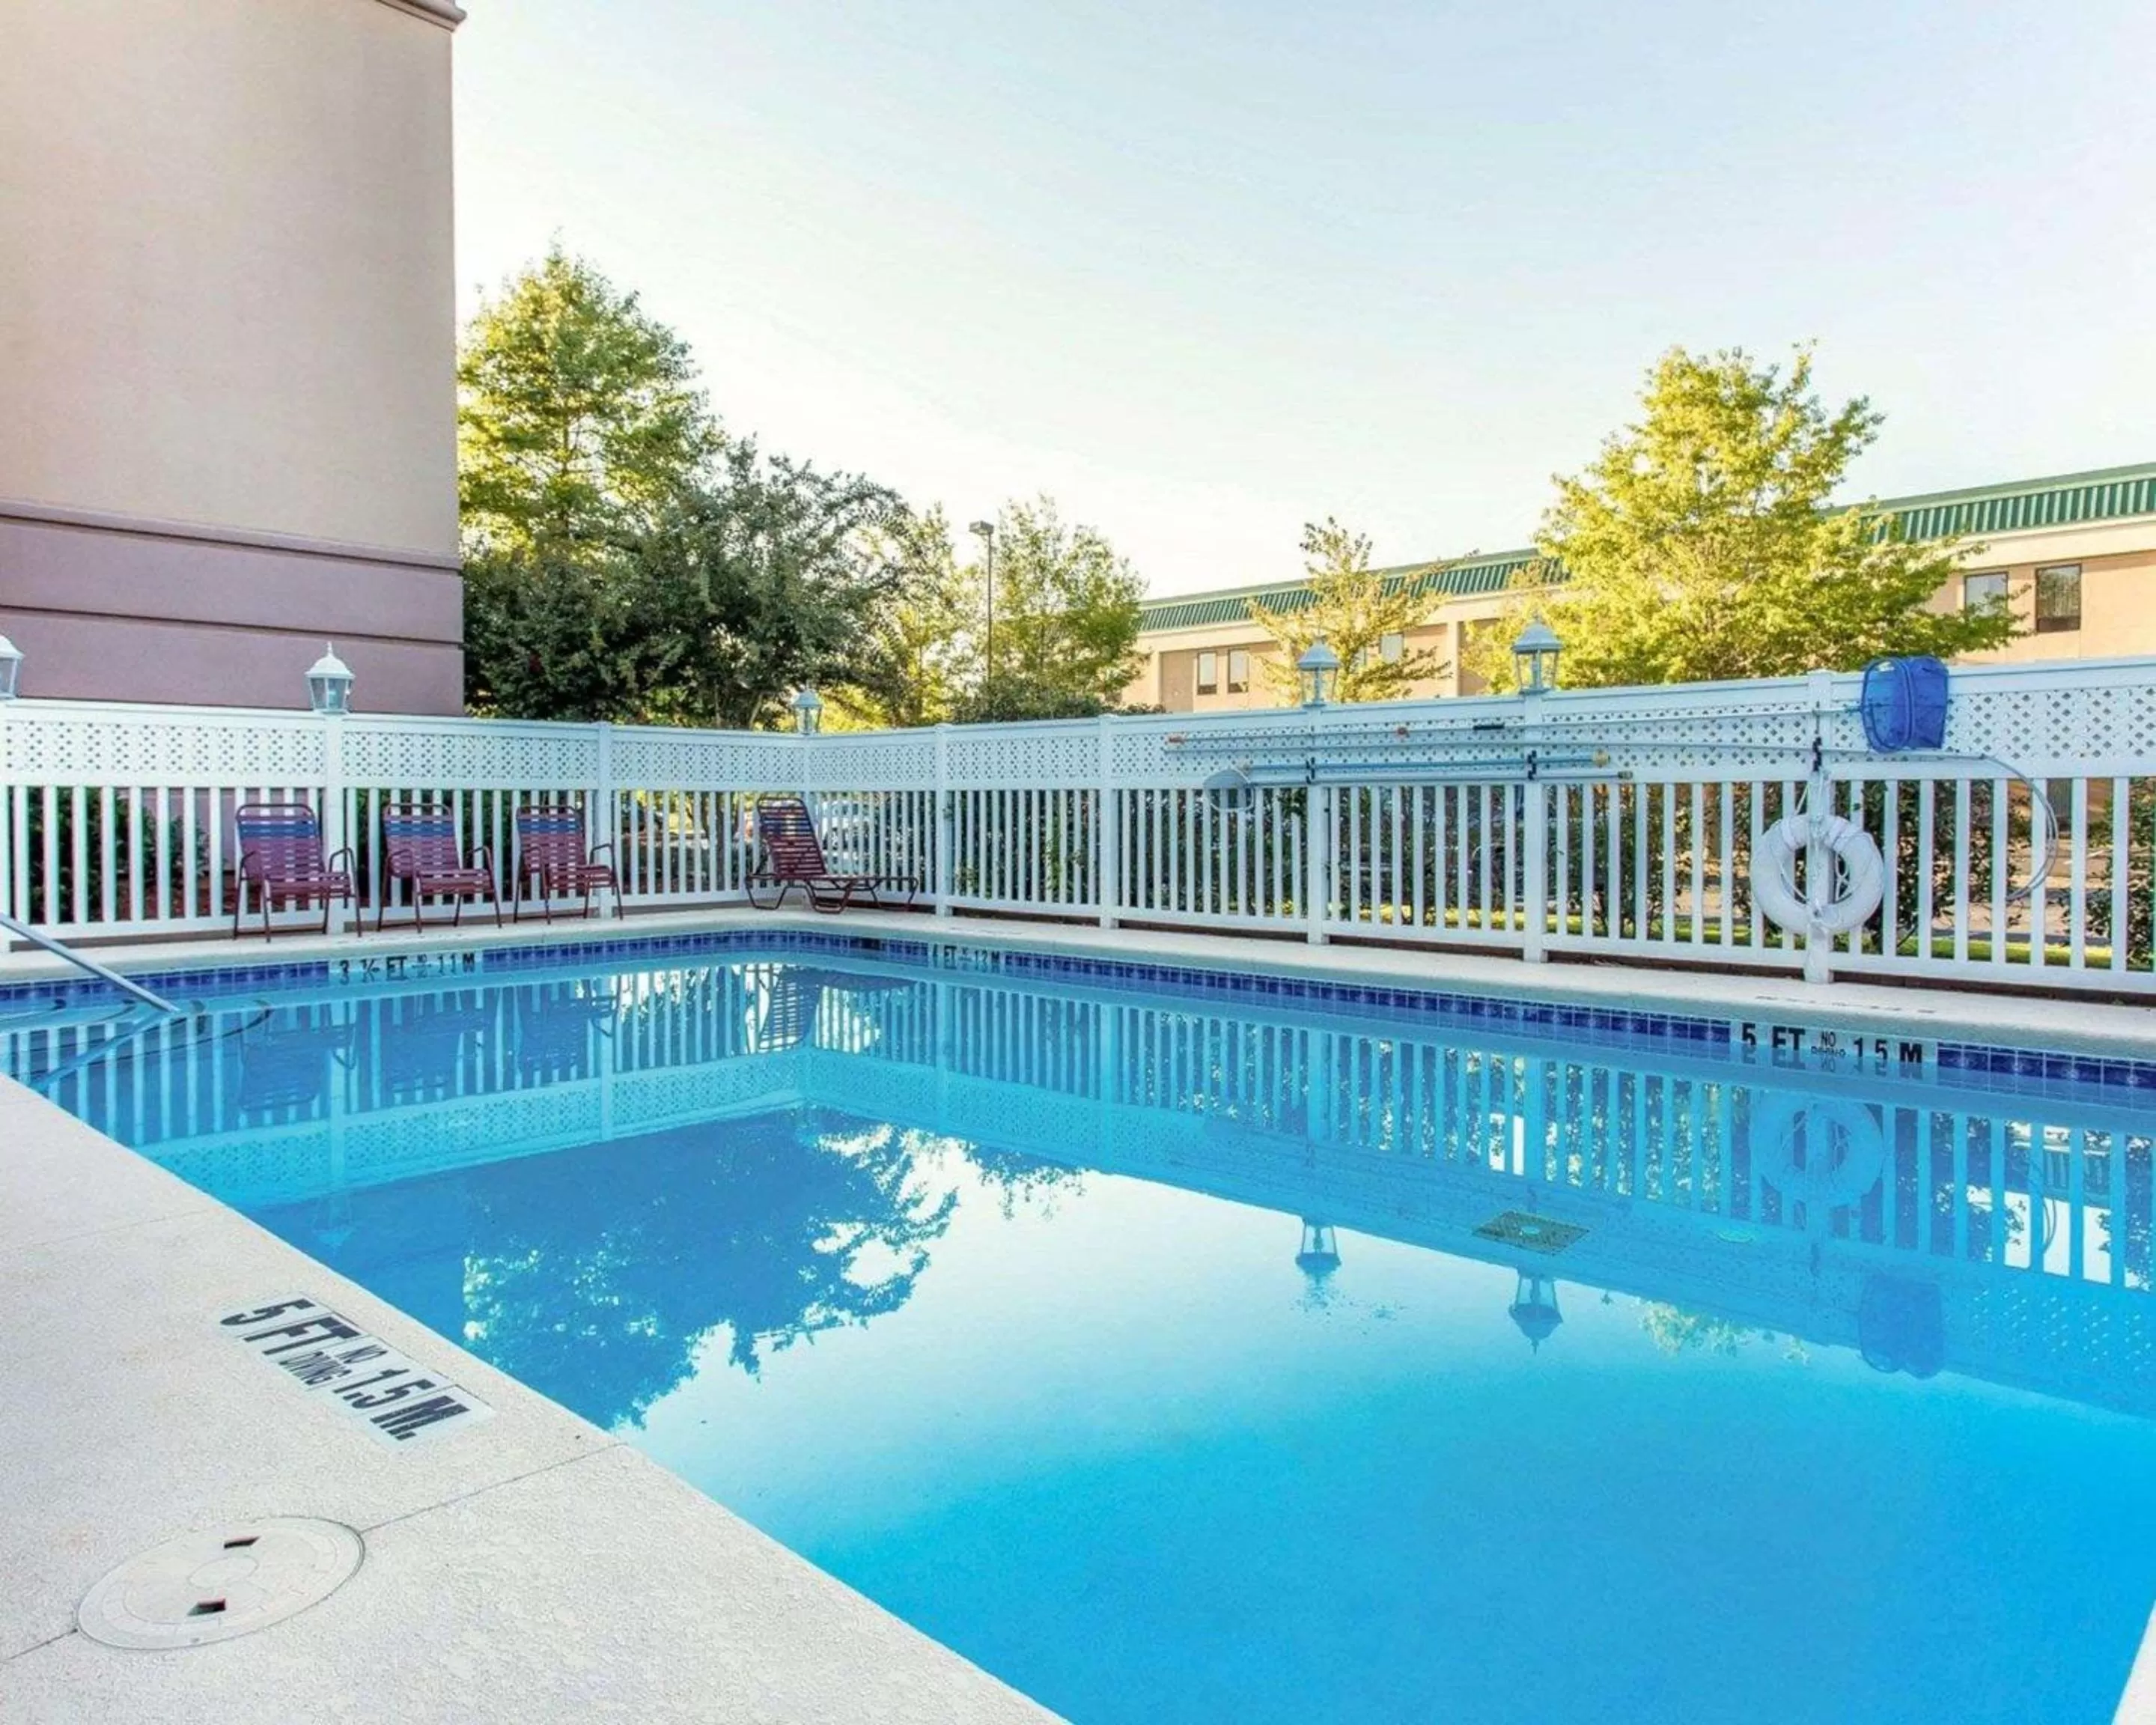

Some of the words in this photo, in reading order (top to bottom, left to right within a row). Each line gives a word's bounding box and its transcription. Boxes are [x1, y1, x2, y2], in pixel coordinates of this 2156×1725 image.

[1741, 1022, 1756, 1046] 5
[1772, 1025, 1806, 1050] FT
[1899, 1041, 1922, 1063] M
[220, 1297, 316, 1326] 5
[243, 1315, 362, 1355] FT
